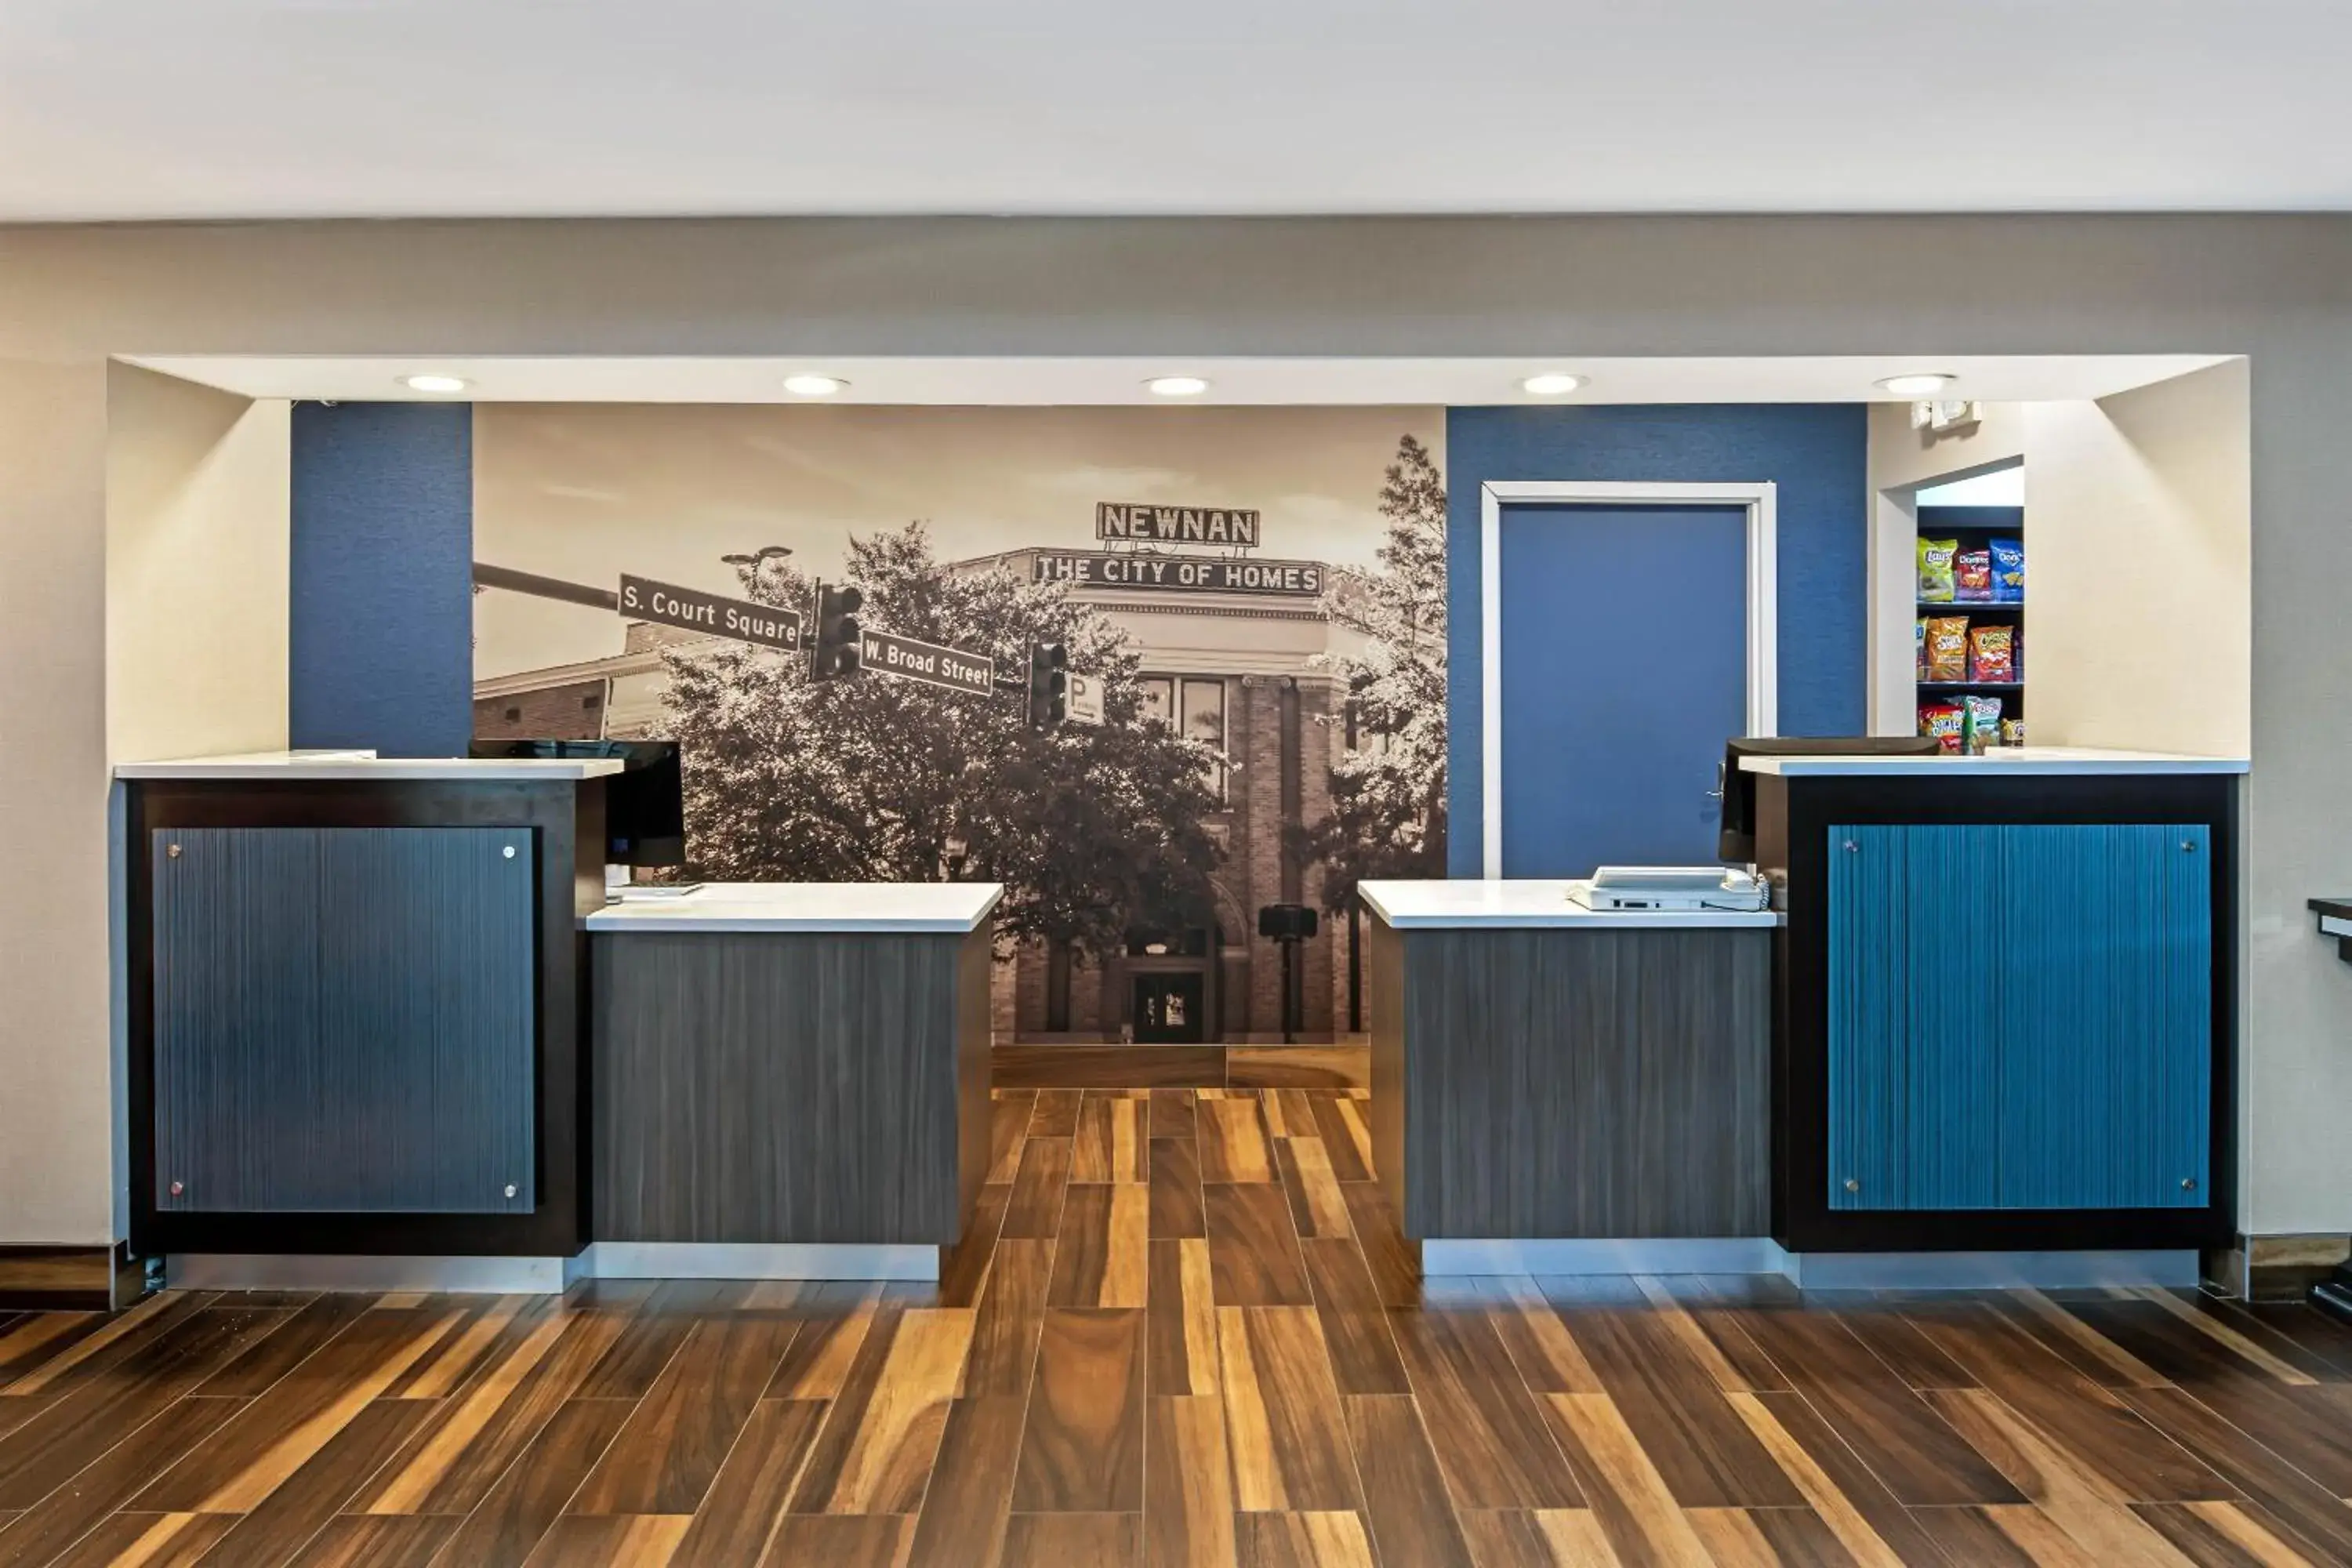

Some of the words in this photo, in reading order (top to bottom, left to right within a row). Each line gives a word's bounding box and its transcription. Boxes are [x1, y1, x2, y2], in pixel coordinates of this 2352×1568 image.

[1104, 506, 1253, 542] NEWNAN
[1038, 557, 1091, 580] THE
[1103, 559, 1167, 583] CITY
[1178, 564, 1213, 586] OF
[1225, 565, 1319, 590] HOMES
[624, 586, 644, 611] S.
[652, 592, 716, 625] Court
[726, 608, 797, 642] Square
[866, 639, 883, 661] W.
[887, 644, 935, 673] Broad
[942, 658, 989, 686] Street
